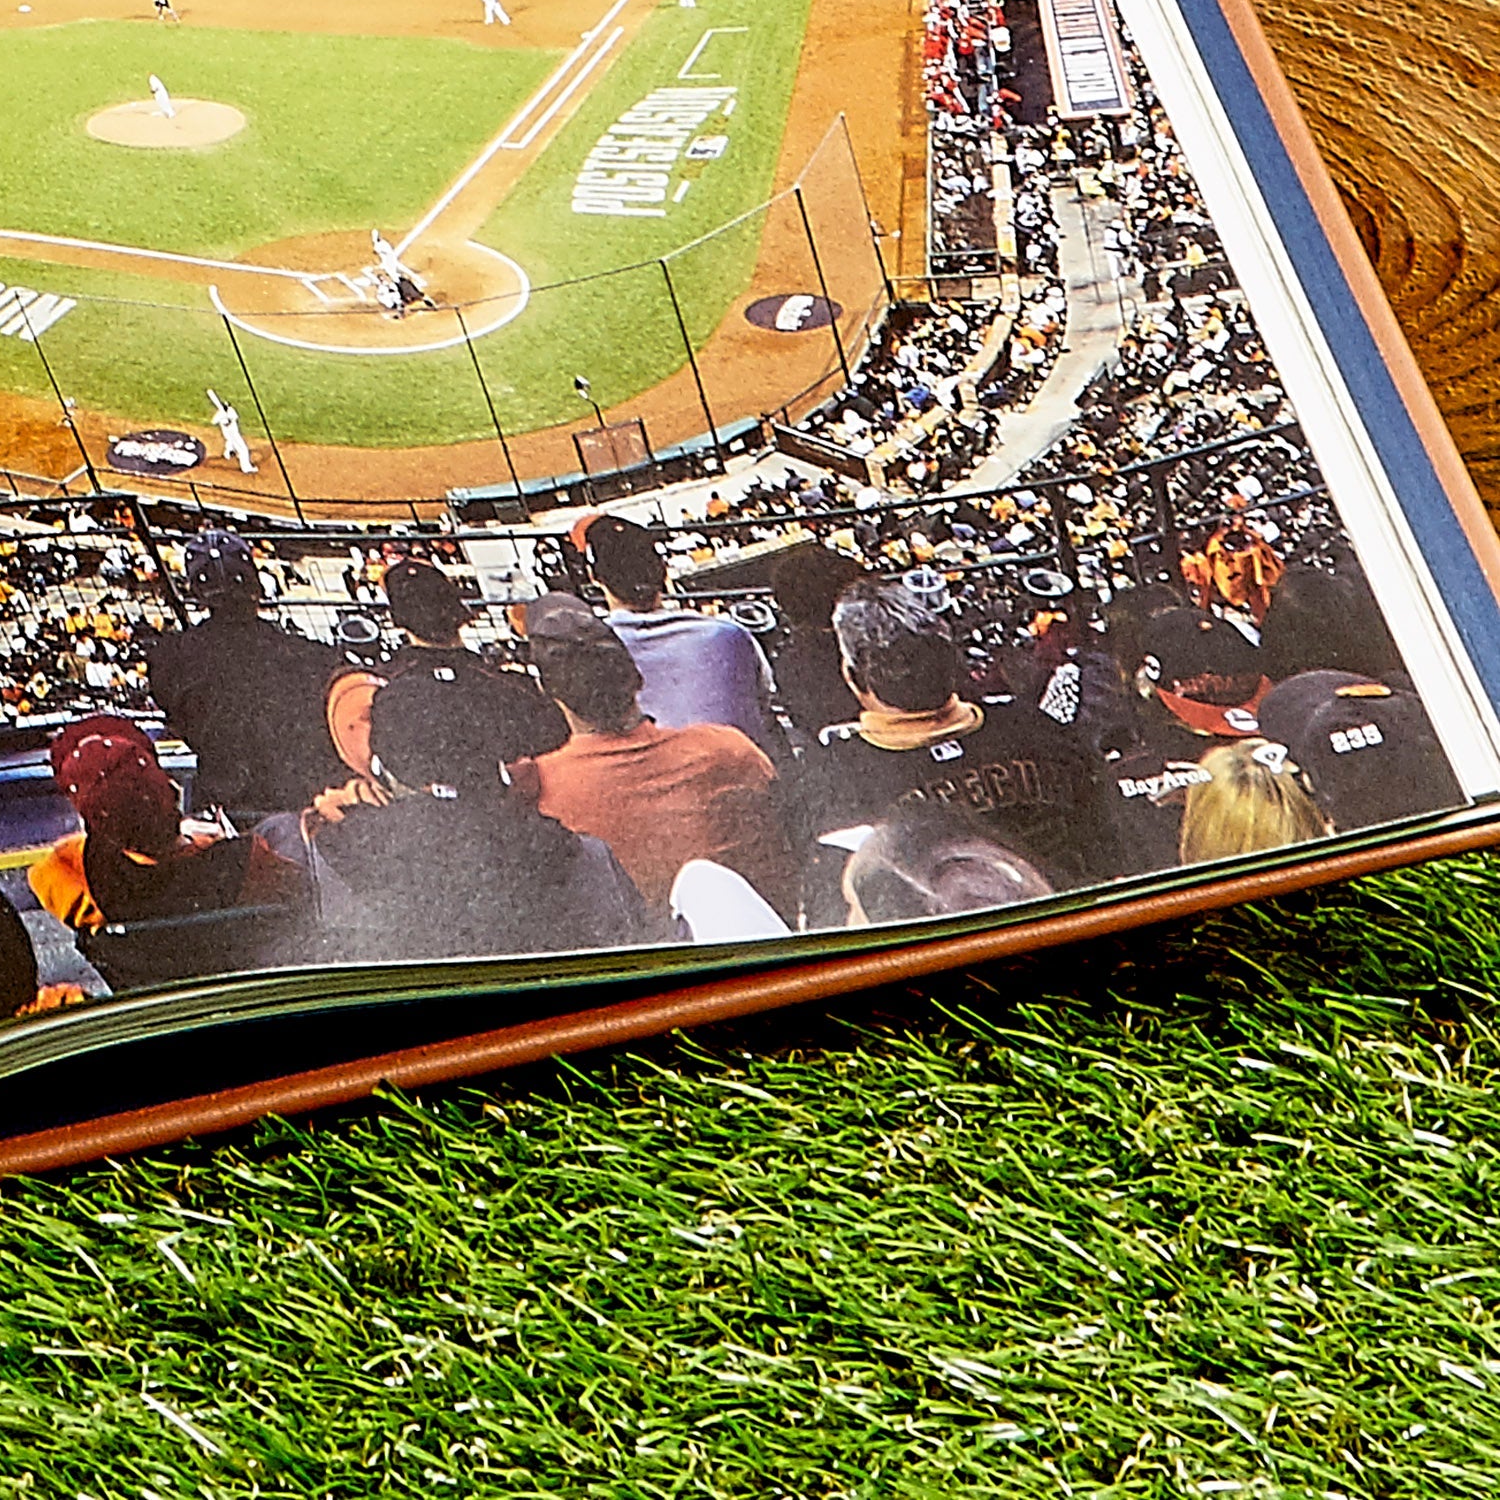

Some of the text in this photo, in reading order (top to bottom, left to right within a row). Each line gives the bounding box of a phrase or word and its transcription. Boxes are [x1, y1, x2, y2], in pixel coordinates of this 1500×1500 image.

[570, 86, 740, 219] POSTSEASON
[1330, 724, 1383, 753] 235
[1118, 767, 1213, 799] Bay Area
